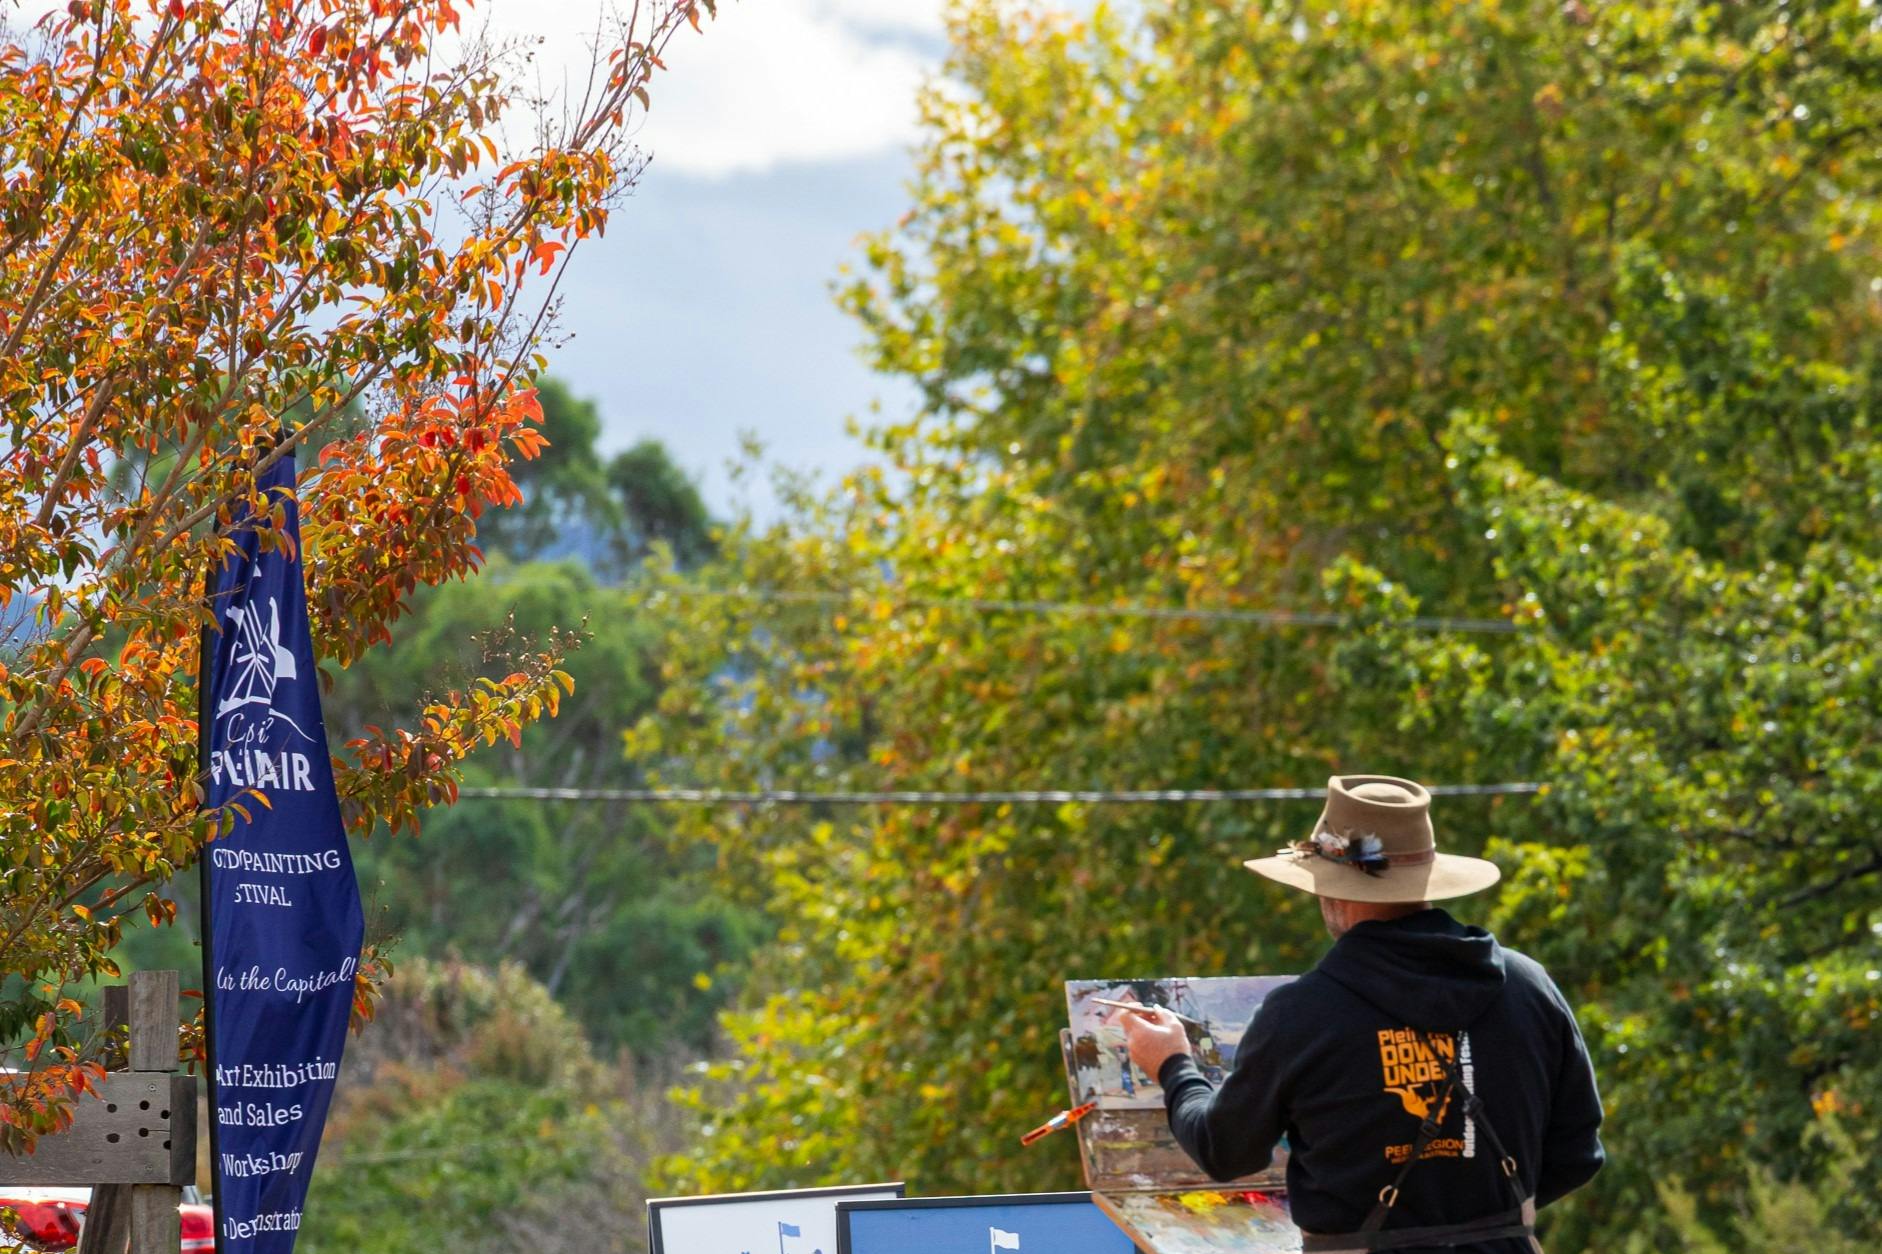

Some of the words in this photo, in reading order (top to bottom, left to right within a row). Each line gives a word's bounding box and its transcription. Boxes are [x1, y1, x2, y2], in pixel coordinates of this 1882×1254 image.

[257, 752, 315, 791] AIR
[243, 849, 341, 874] PAINTING
[234, 883, 292, 906] STIVAL
[240, 965, 271, 990] the
[274, 956, 357, 1004] Capital!
[216, 1063, 240, 1086] Art
[242, 1056, 336, 1088] Exhibition
[1384, 1062, 1447, 1087] UNDE
[217, 1102, 243, 1126] and
[246, 1103, 303, 1127] Sales
[222, 1151, 304, 1177] Workshop
